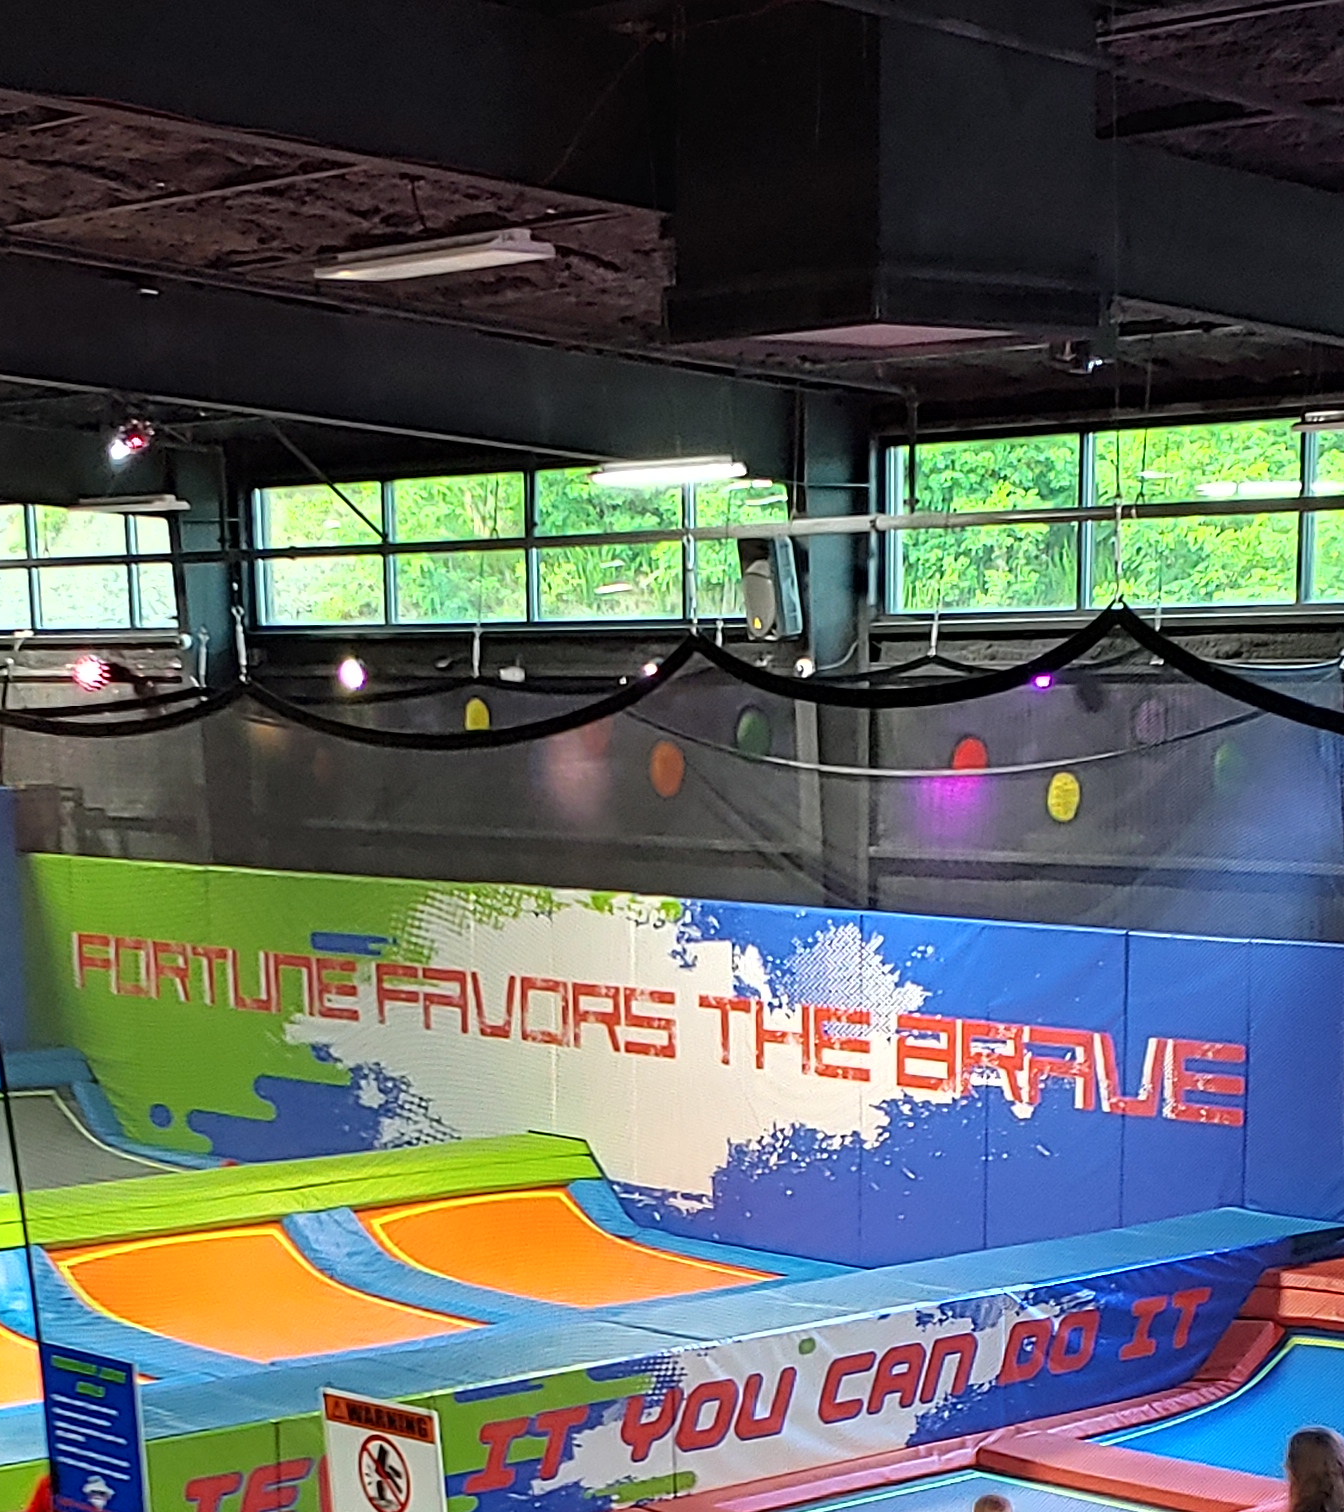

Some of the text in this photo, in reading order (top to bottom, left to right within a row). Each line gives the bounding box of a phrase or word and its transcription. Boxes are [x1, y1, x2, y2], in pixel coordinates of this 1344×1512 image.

[72, 930, 1247, 1128] FORTUNE FAVORS THE BRAVE
[346, 1401, 429, 1439] WARNING
[465, 1286, 1213, 1495] IT YOU CAN DO IT
